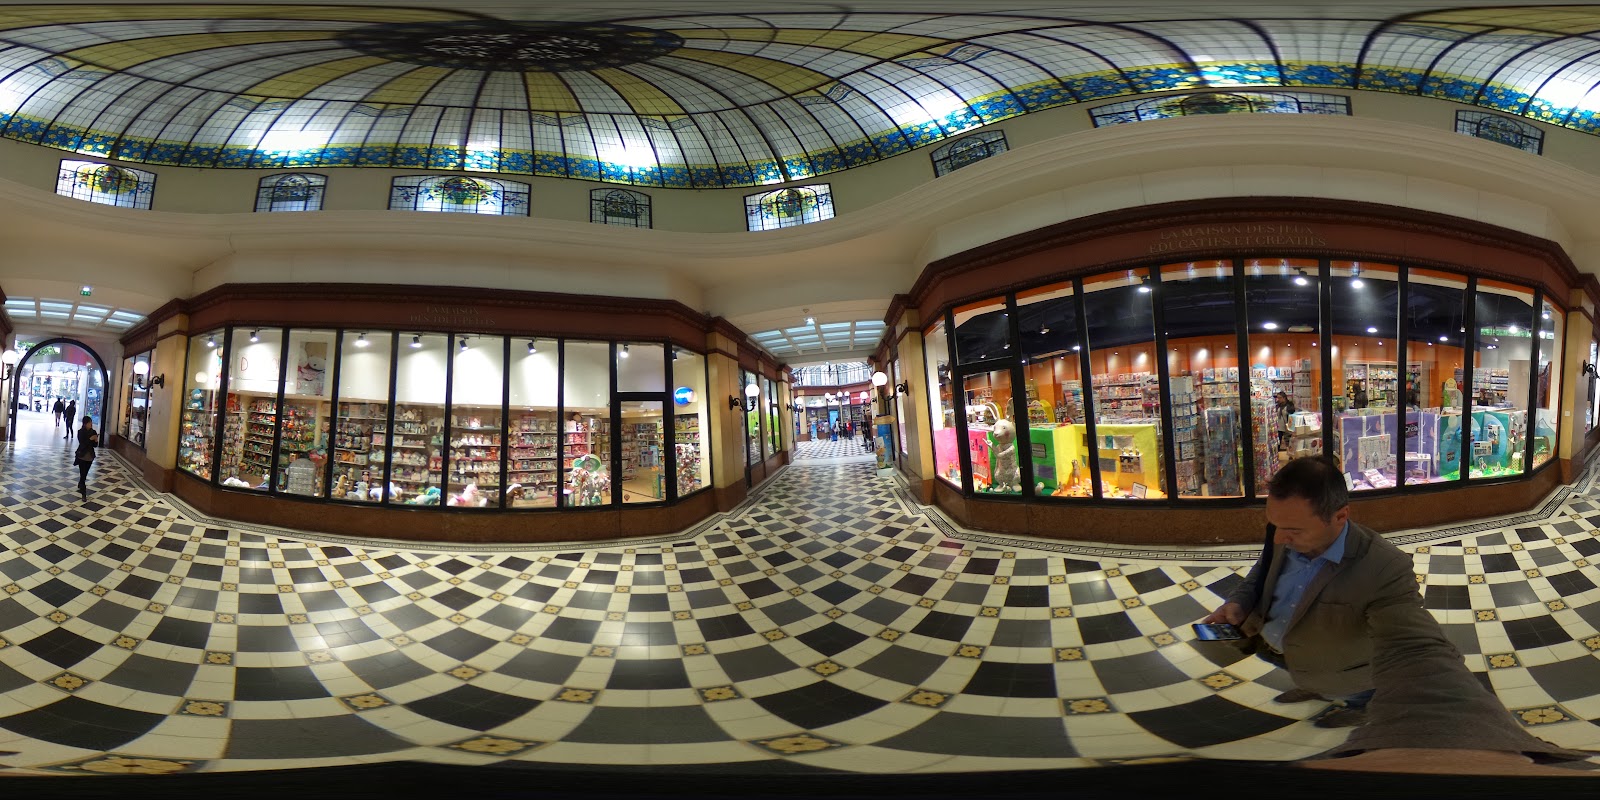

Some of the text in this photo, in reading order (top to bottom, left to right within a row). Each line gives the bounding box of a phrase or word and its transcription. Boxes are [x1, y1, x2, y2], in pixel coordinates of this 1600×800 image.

[1161, 224, 1313, 240] LA MAISON DES JEUX
[1235, 236, 1251, 246] ET
[426, 305, 479, 315] LA MAISON
[410, 314, 430, 323] DES
